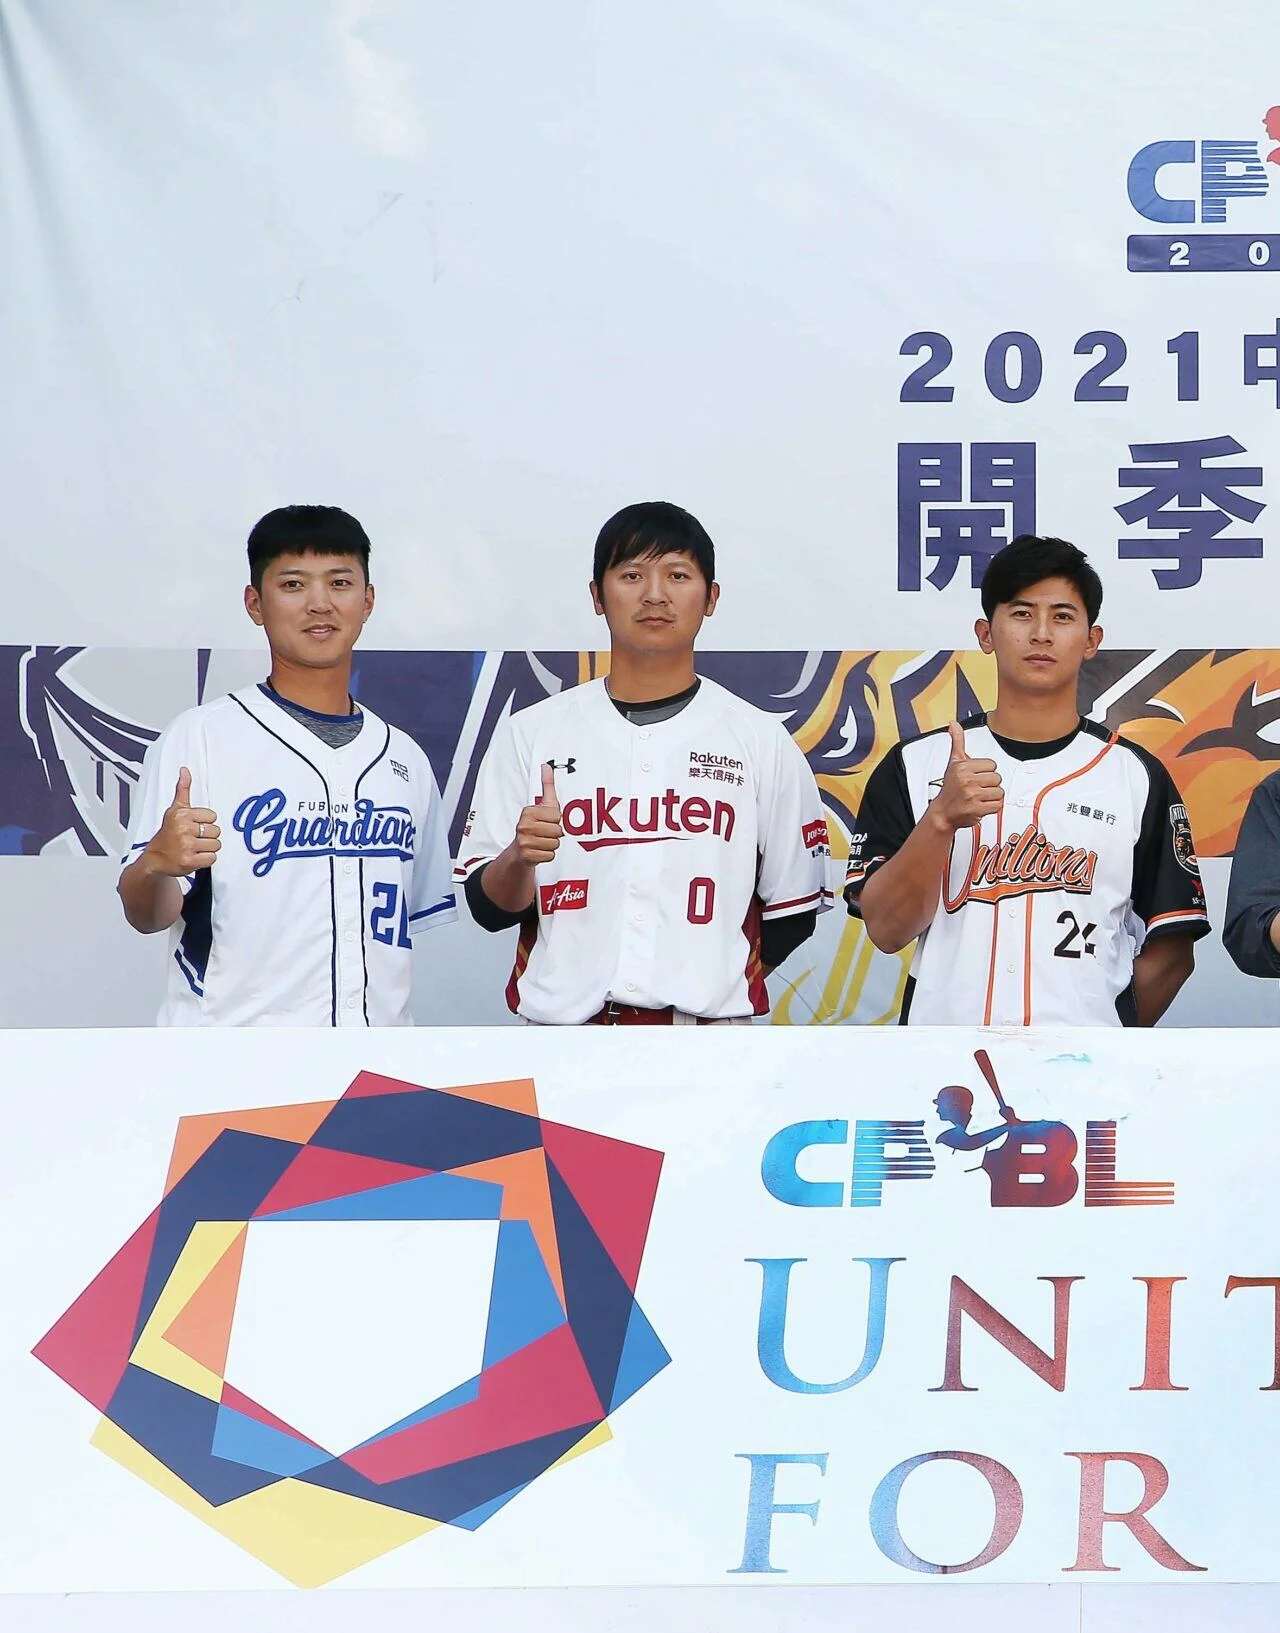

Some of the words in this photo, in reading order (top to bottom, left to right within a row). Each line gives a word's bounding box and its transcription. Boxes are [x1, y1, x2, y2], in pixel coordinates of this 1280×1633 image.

[688, 767, 745, 787] 樂天信用卡
[689, 751, 743, 771] Rakuten
[535, 787, 735, 843] akuten
[1066, 801, 1117, 827] 兆豐銀行
[686, 877, 716, 925] 0
[761, 1119, 1176, 1208] CPBL
[725, 1449, 1208, 1575] FOR
